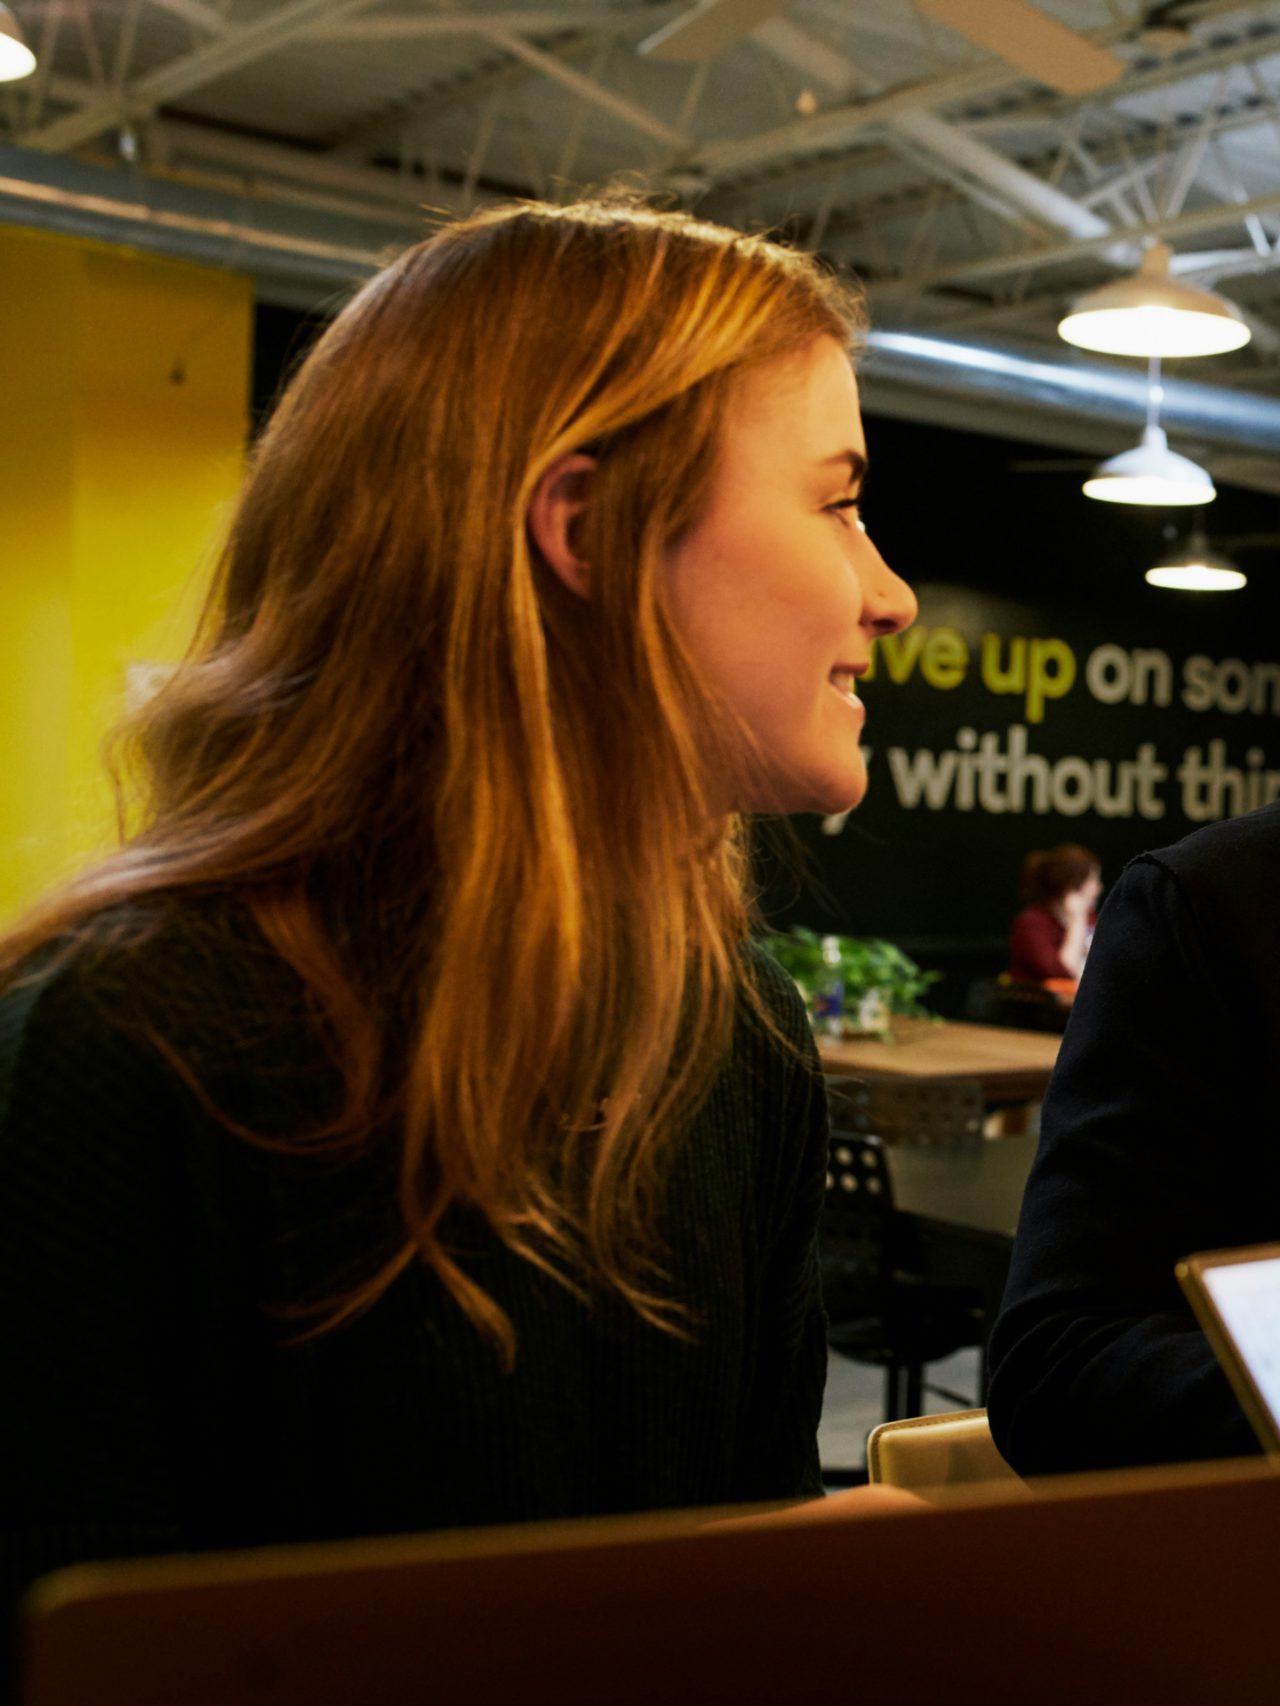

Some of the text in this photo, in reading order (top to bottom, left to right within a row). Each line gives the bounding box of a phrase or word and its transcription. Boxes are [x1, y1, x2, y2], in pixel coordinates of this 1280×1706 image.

[981, 633, 1076, 722] up
[1086, 643, 1173, 708] on
[886, 725, 1168, 821] without
